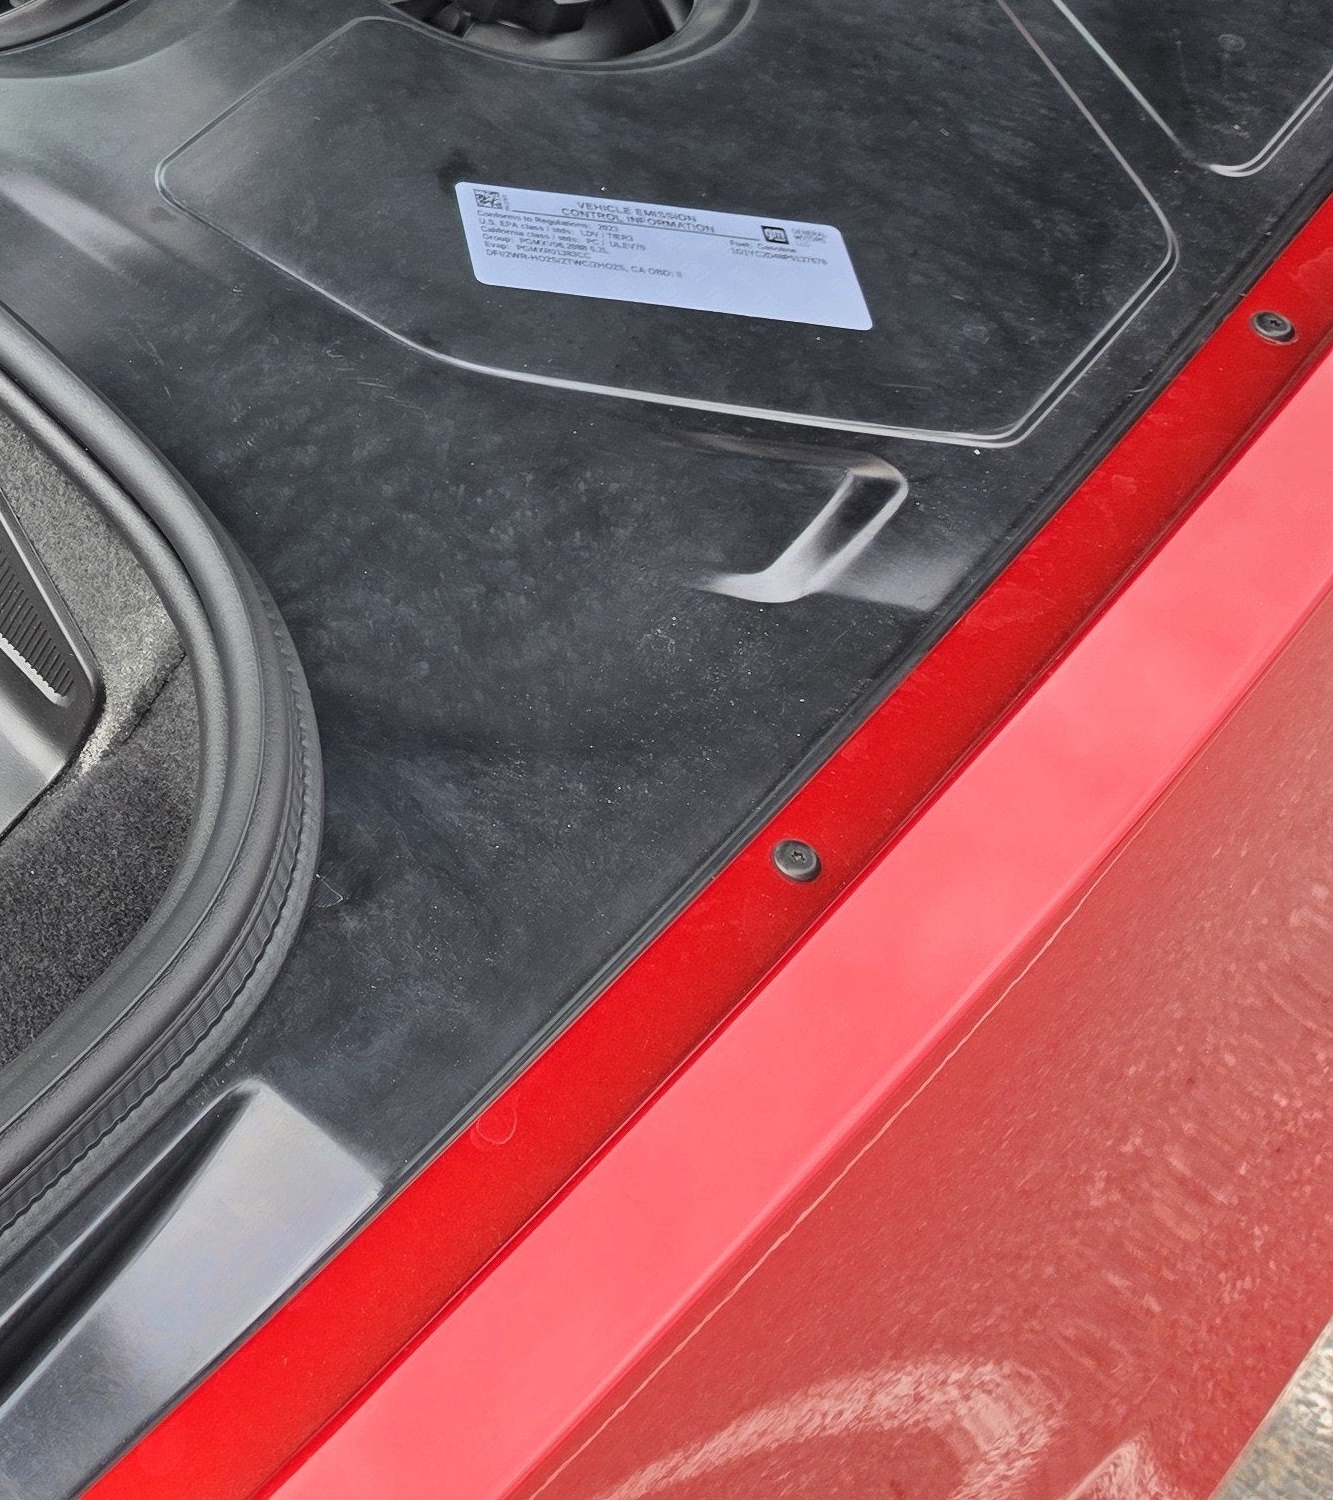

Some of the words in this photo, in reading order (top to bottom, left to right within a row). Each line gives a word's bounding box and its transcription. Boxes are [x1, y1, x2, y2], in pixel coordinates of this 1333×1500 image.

[560, 207, 622, 221] CONTROL
[625, 215, 715, 232] INFORMATION
[576, 201, 630, 214] VEHICLE
[634, 208, 697, 222] EMISSION
